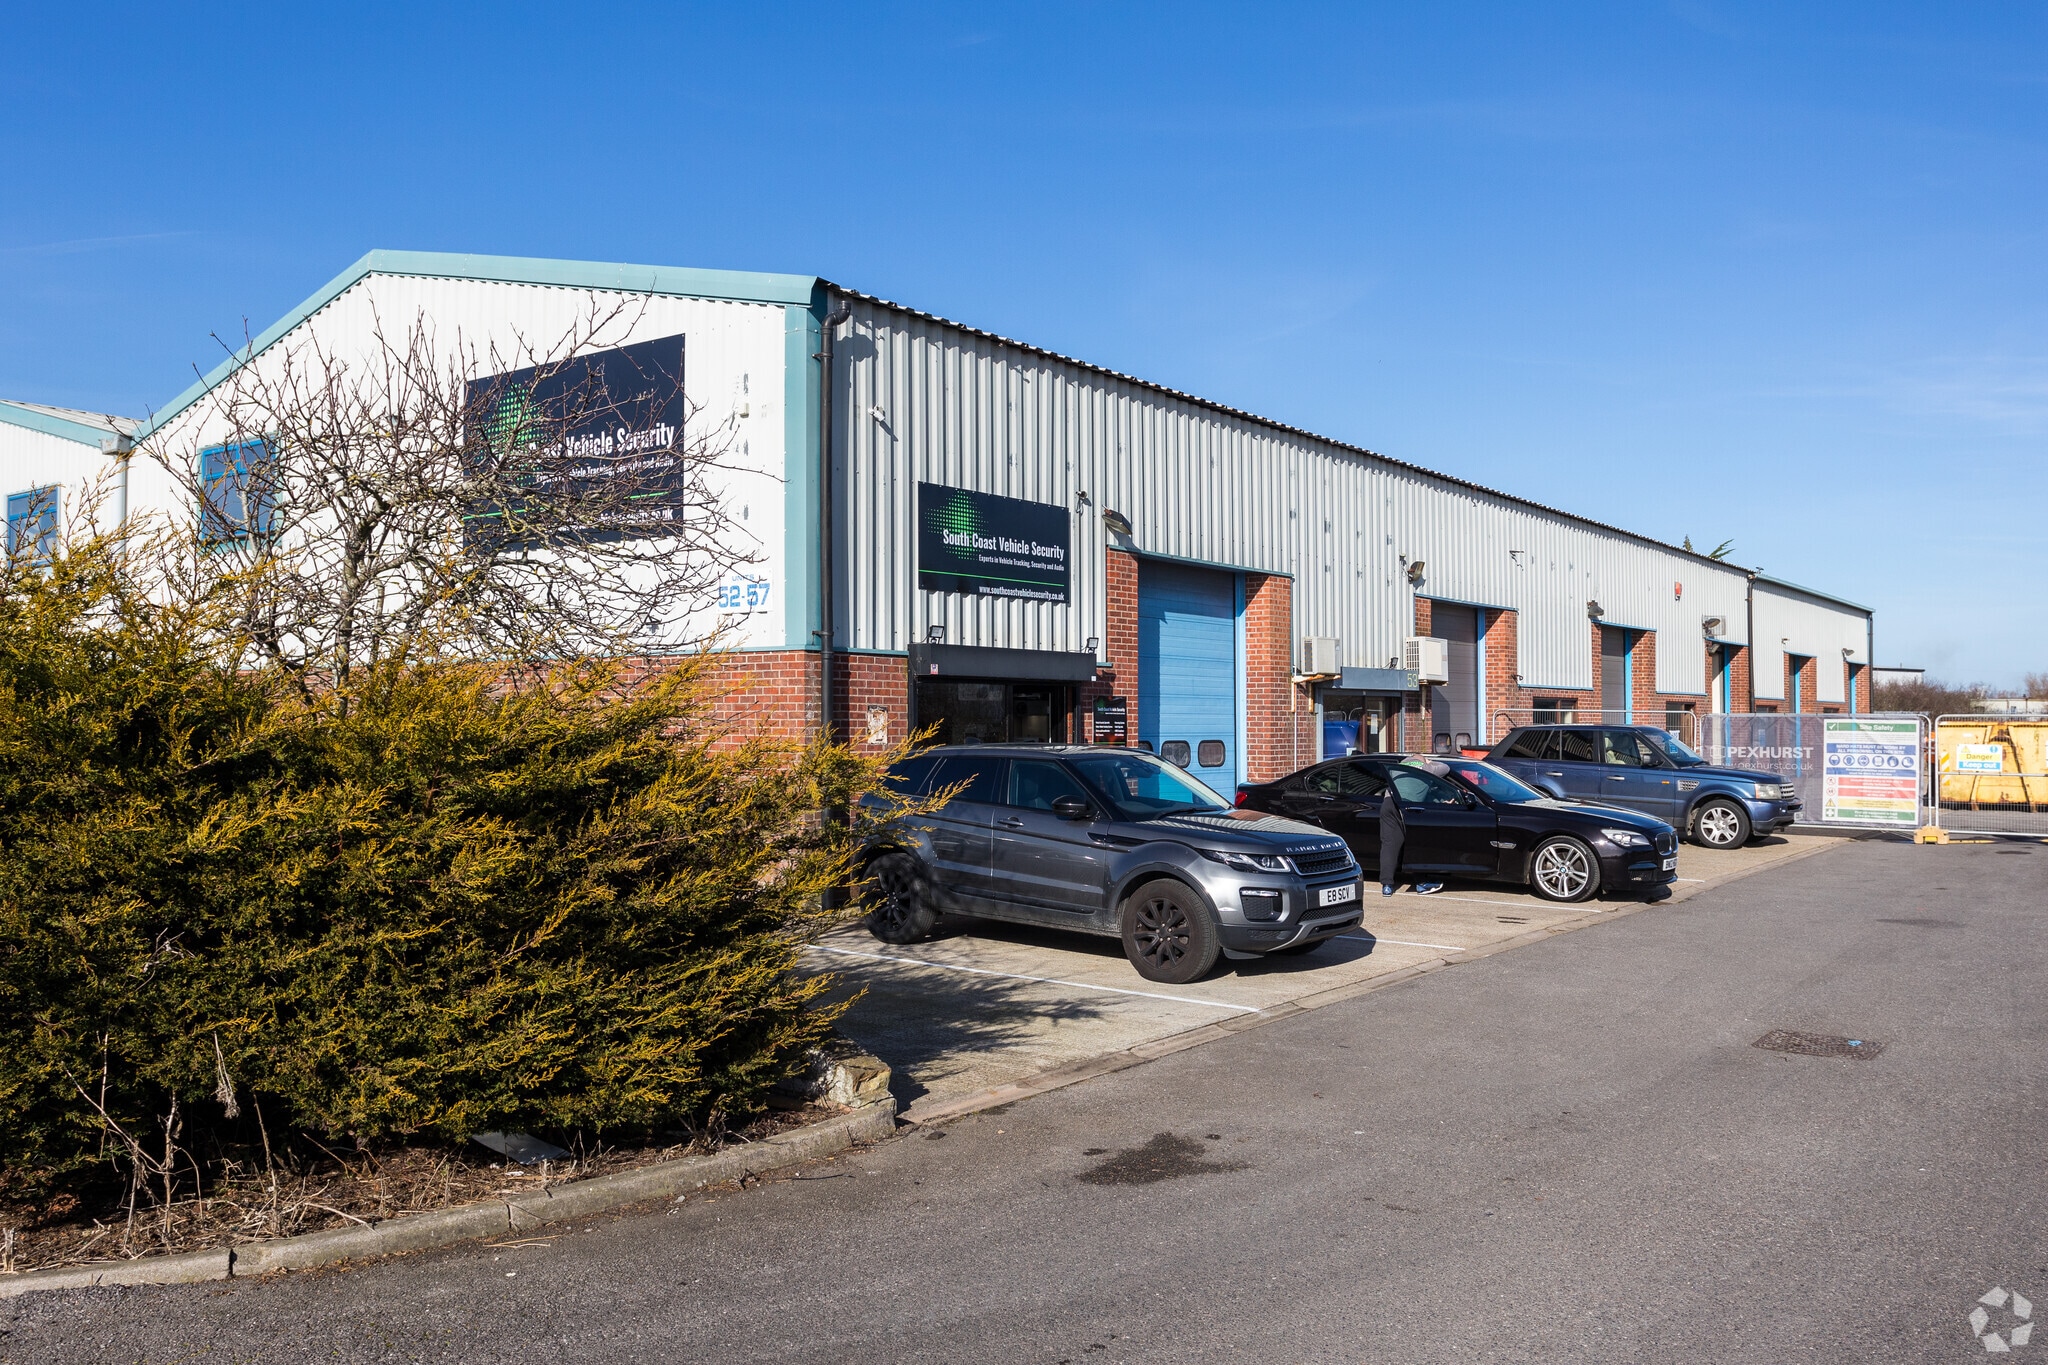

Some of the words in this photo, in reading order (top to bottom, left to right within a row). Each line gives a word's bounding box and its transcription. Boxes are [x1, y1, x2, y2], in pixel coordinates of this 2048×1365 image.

[565, 431, 613, 457] Vehicle
[616, 422, 675, 451] Security
[943, 529, 970, 547] South
[972, 533, 997, 550] Coast
[998, 537, 1030, 555] Vehicle
[1031, 541, 1065, 561] Security
[978, 554, 994, 563] Experts
[999, 556, 1013, 565] Vehicle
[1031, 561, 1047, 570] Security
[718, 583, 770, 607] 52-57
[1407, 673, 1418, 688] 53
[1873, 724, 1894, 732] Safety
[1727, 746, 1814, 759] PEXHURST
[1966, 753, 1993, 761] Danger
[1962, 761, 1982, 769] Keep
[1327, 889, 1337, 903] E8
[1338, 886, 1350, 901] SCV
